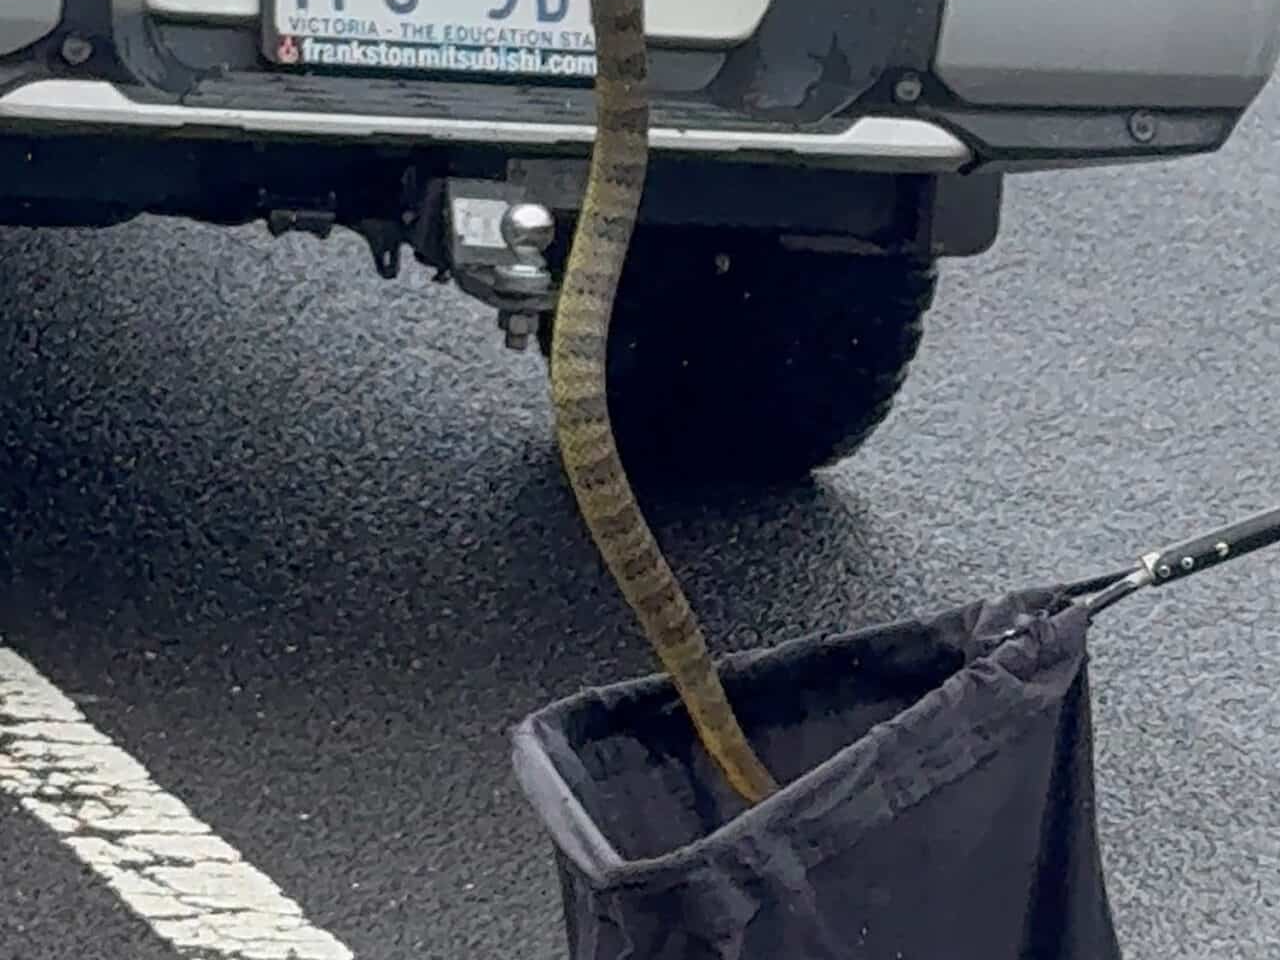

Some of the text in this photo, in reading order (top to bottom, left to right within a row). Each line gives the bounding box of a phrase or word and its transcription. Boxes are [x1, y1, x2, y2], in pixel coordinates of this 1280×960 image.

[288, 16, 378, 38] VICTORIA
[400, 21, 435, 41] THE
[444, 25, 554, 47] EDUCATION
[560, 30, 595, 49] STA
[303, 37, 597, 75] frankstonmitsubishi.com
